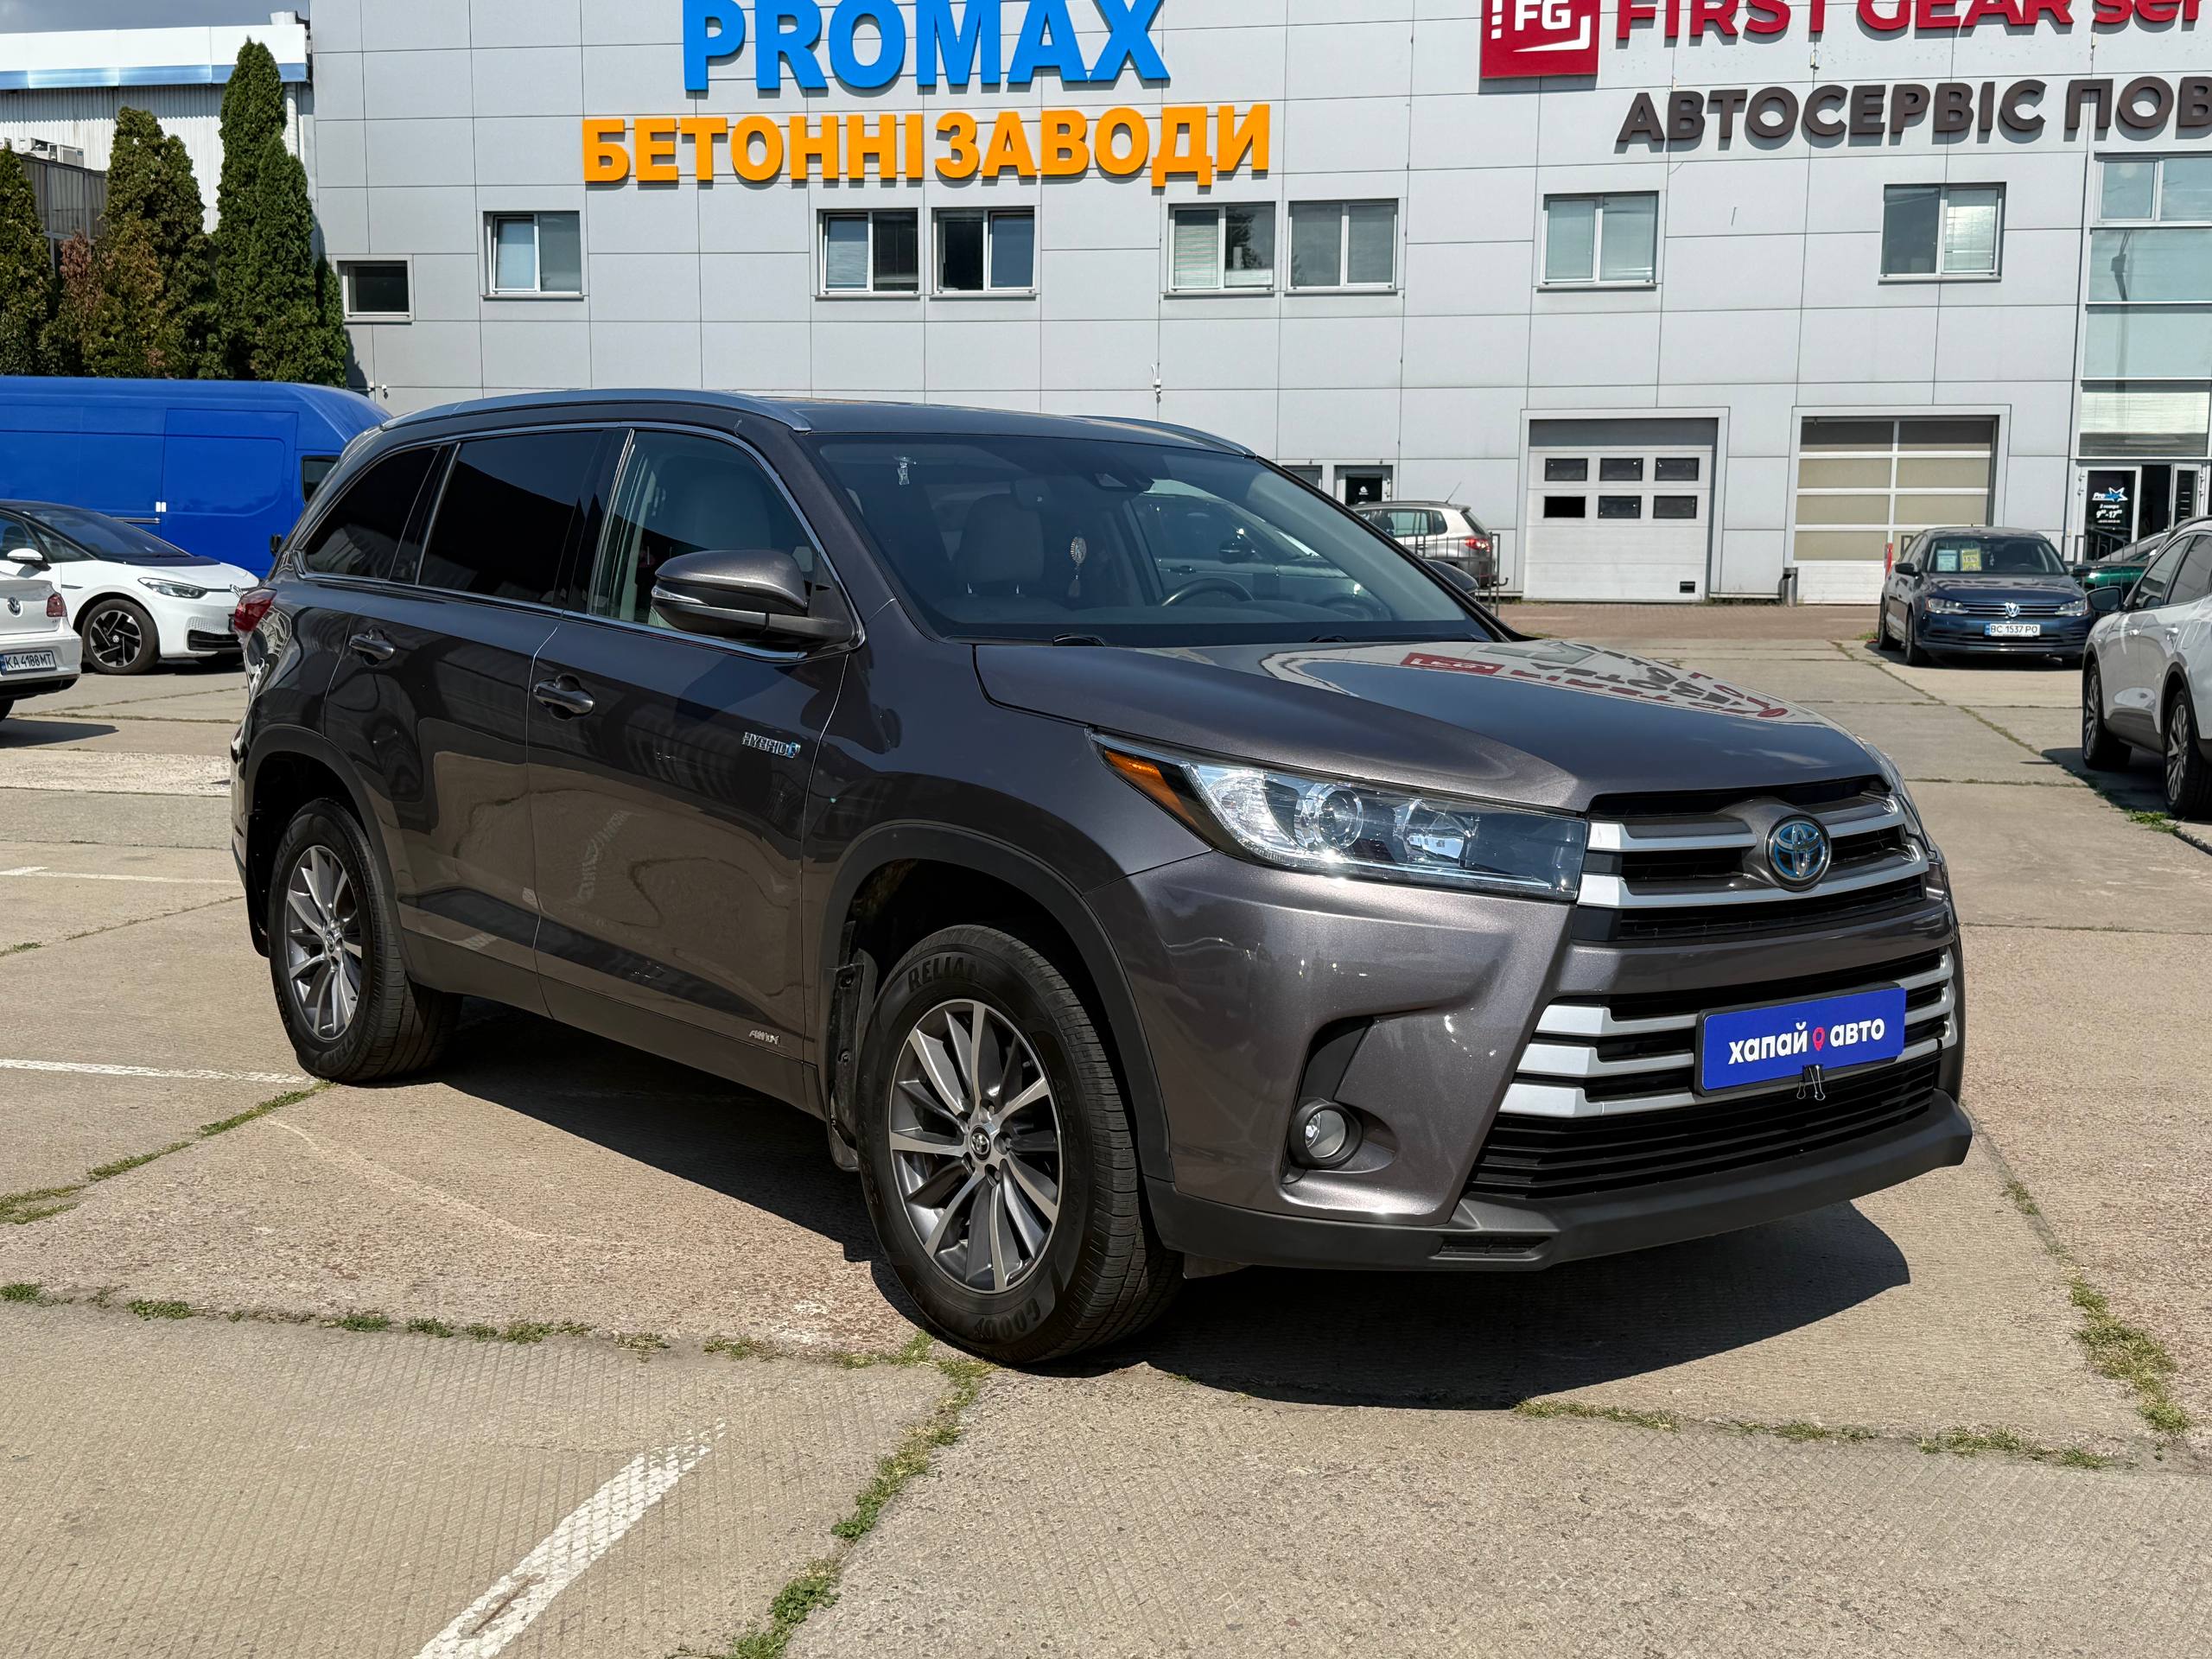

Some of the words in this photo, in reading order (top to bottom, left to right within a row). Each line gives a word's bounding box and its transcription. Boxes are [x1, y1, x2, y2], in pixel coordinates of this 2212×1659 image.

[683, 0, 1171, 91] PROMAX
[1616, 79, 2048, 143] АВТОСЕРВІС
[582, 113, 923, 182] БЕТОННІ
[934, 103, 1271, 188] ЗАВОДИ
[1990, 625, 2004, 633] BC
[2005, 625, 2024, 633] 1537
[5, 656, 20, 669] KA
[907, 956, 981, 995] RELIAN
[1728, 1021, 1808, 1065] хапай
[1829, 1018, 1885, 1047] авто
